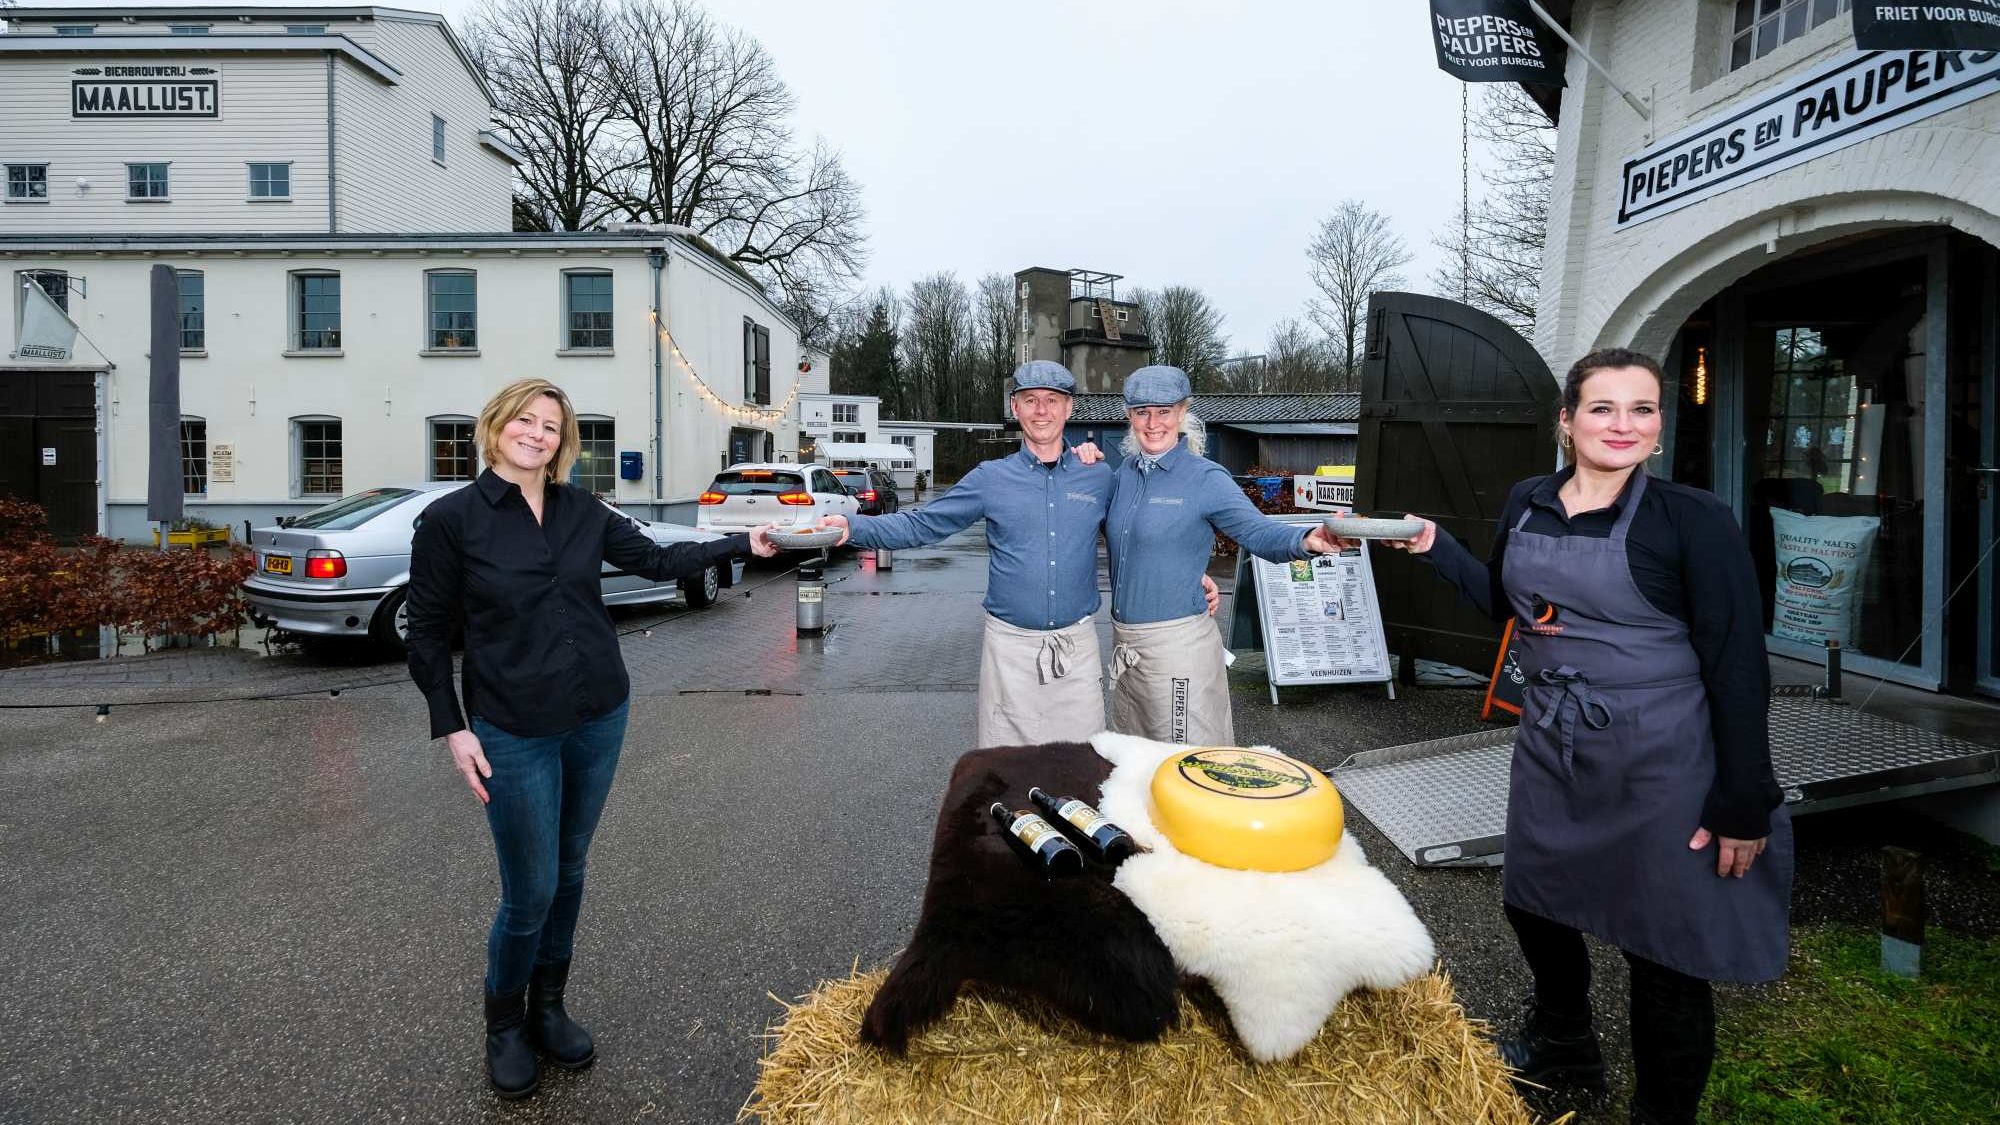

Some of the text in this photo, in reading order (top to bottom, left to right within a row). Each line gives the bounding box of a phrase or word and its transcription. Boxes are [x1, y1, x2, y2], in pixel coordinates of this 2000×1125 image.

[1875, 6, 1919, 21] FRIET
[1922, 7, 1966, 21] VOOR
[1436, 12, 1535, 38] PIEPERS EN
[1440, 31, 1541, 57] PAUPERS
[1444, 51, 1545, 69] FRIET VOOR BURGERS
[104, 66, 187, 77] BIERBROUWERIJ
[78, 86, 213, 111] MAALLUST.
[1630, 128, 1746, 204] PIEPERS
[1754, 114, 1783, 148] EN
[1318, 486, 1335, 501] KAAS
[1780, 534, 1857, 549] QUALITY MALTS
[1810, 548, 1857, 559] MALTING
[1310, 668, 1352, 677] VEENHUIZEN
[1175, 681, 1185, 717] PIEPERS
